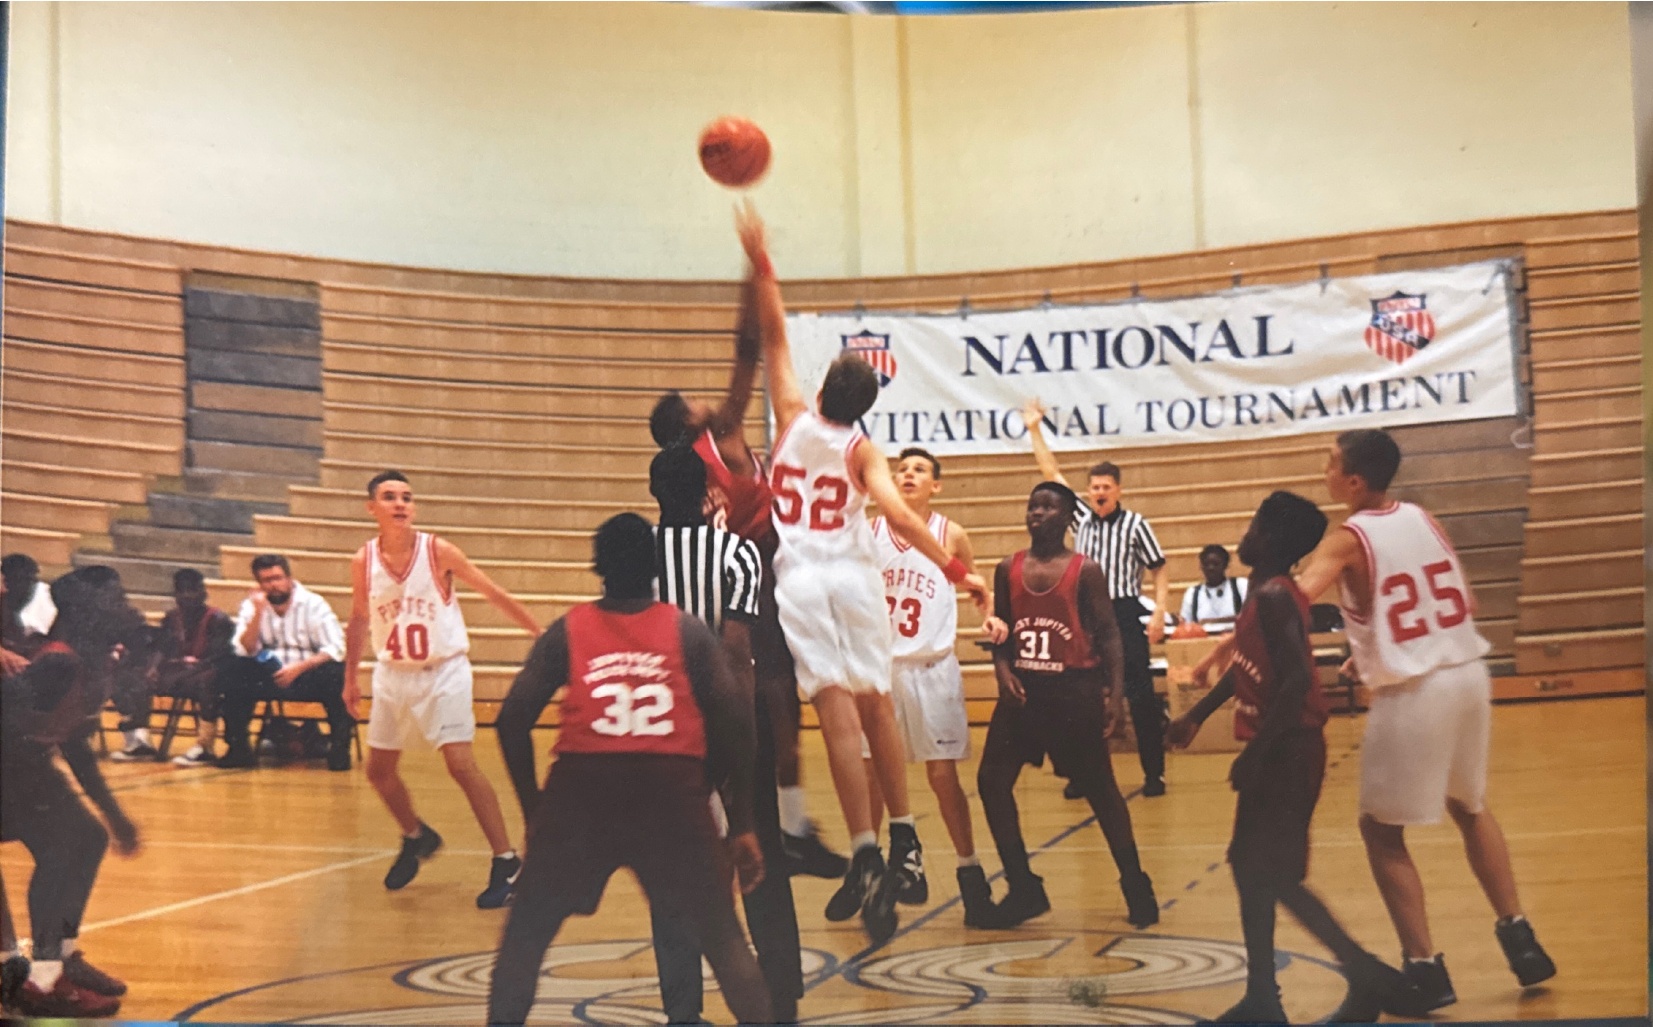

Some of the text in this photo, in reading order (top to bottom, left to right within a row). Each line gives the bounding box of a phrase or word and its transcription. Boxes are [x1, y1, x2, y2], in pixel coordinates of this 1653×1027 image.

[961, 314, 1294, 377] NATIONAL
[857, 370, 1476, 444] VITATIONAL TOURNAMENT
[771, 464, 848, 531] 52
[882, 568, 936, 600] RATES
[1380, 559, 1468, 644] 25
[386, 622, 430, 661] 40
[1020, 630, 1051, 660] 31
[590, 682, 675, 737] 32
